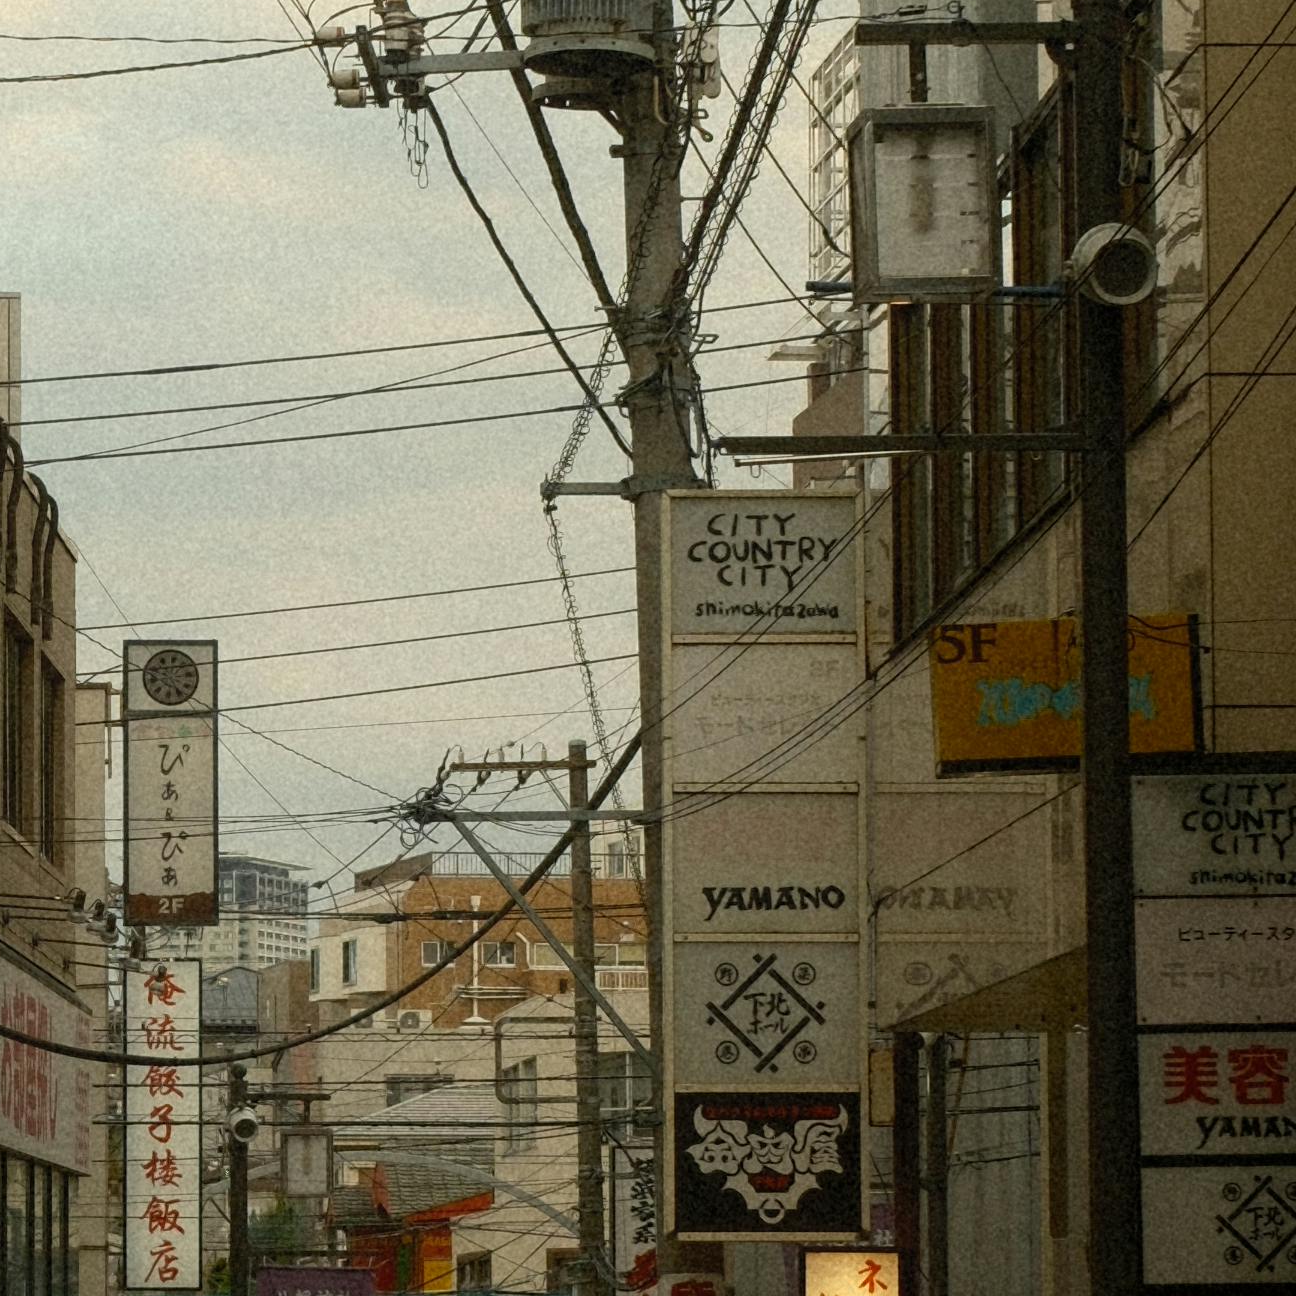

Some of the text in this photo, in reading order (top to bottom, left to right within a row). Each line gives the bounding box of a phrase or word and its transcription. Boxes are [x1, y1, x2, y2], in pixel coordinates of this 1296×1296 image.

[707, 513, 796, 537] CITY
[687, 536, 837, 563] COUNTRY
[717, 564, 803, 592] CITY
[1200, 782, 1286, 805] CITY
[1211, 833, 1294, 861] CITY
[158, 897, 185, 915] 2F
[702, 884, 846, 922] YAMANO
[1163, 1045, 1289, 1105] 美容
